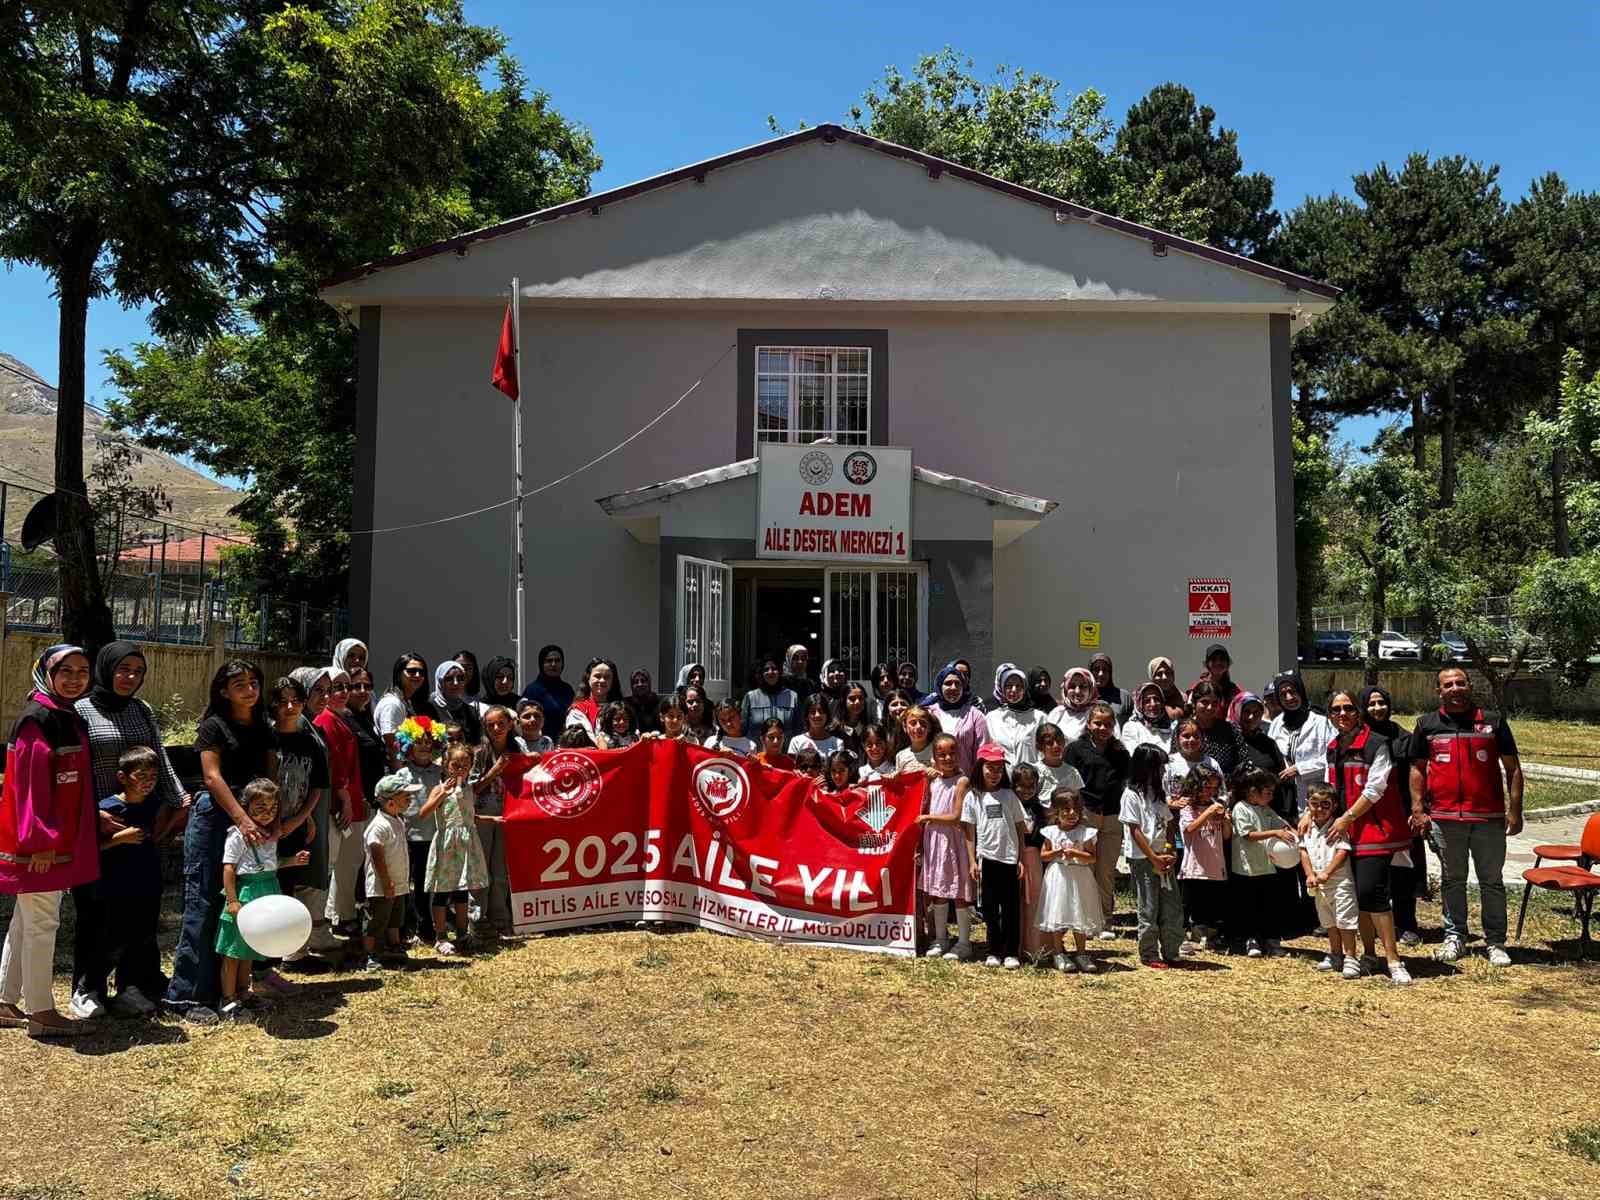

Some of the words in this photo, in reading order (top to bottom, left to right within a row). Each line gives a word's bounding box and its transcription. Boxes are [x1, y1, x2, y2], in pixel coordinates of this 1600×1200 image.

[799, 491, 871, 517] ADEM
[764, 527, 790, 551] AİLE
[793, 529, 837, 553] DESTEK
[840, 529, 893, 555] MERKEZİ
[896, 532, 906, 555] 1
[540, 829, 661, 882] 2025
[672, 830, 779, 898] AİLE
[797, 863, 893, 912] YILI
[523, 893, 577, 918] BİTLİS
[582, 890, 619, 912] AİLE
[625, 890, 645, 906] VE
[645, 890, 687, 908] SOSAL
[692, 894, 779, 932] HİZMETLER
[782, 914, 796, 934] İL
[802, 920, 912, 942] MÜDÜRLÜĞÜ
